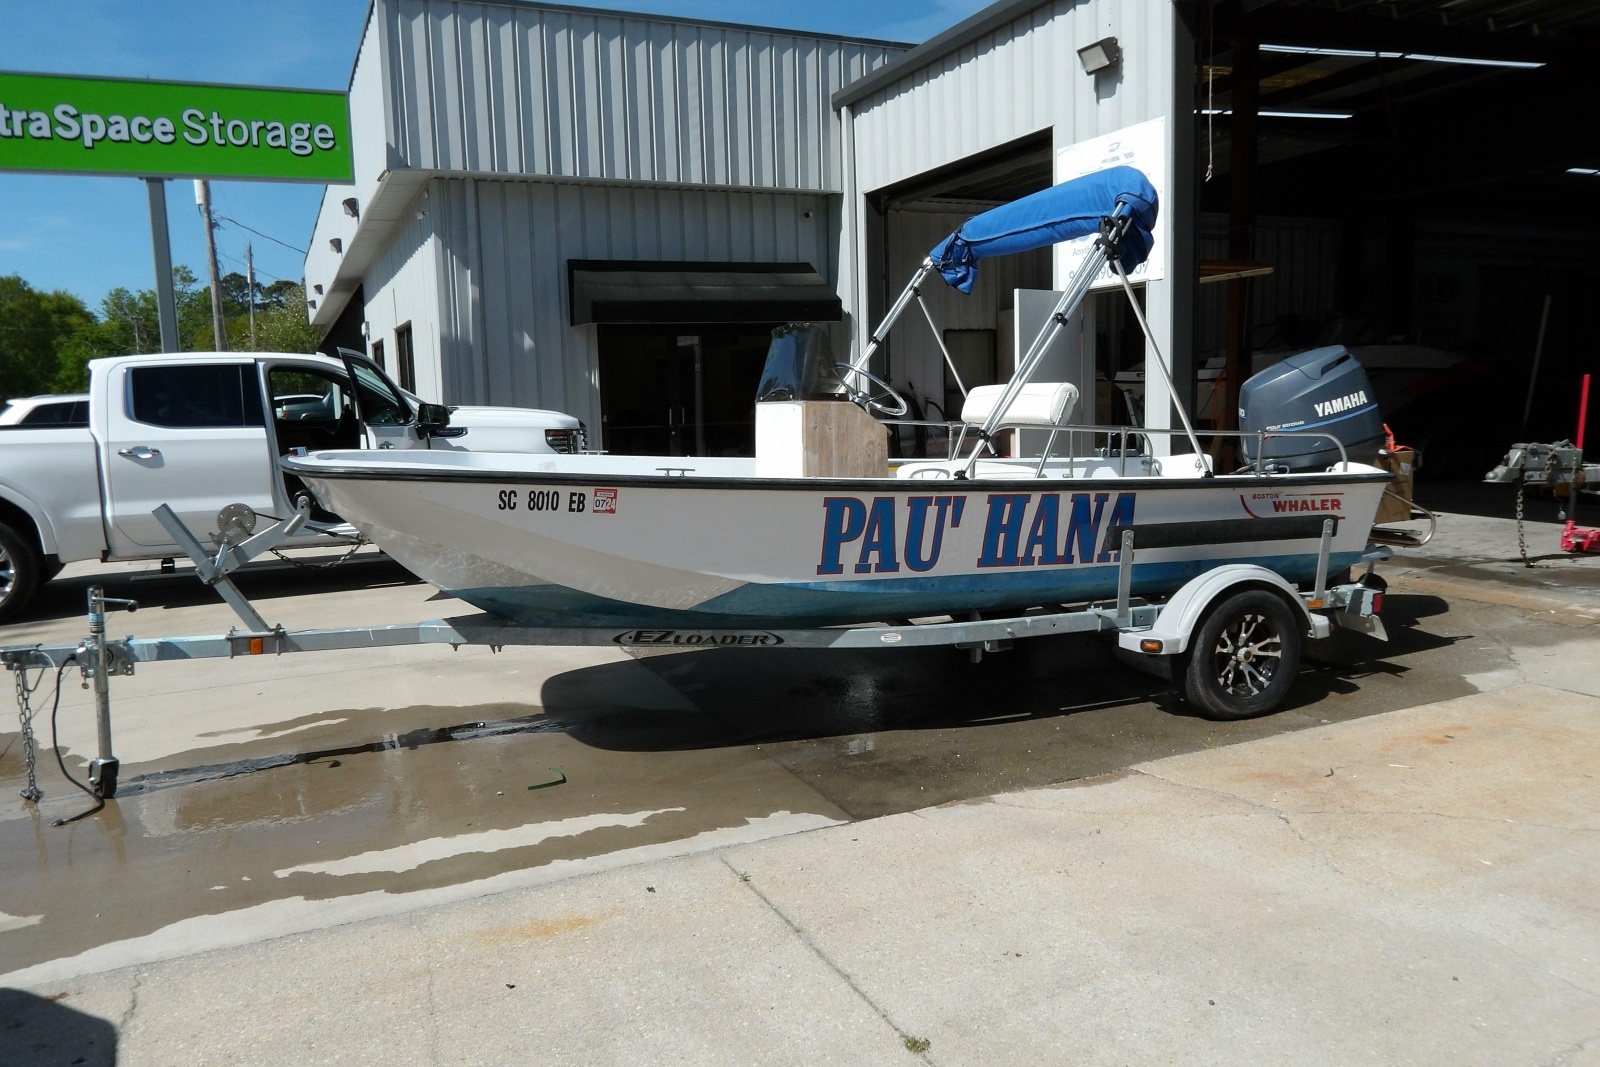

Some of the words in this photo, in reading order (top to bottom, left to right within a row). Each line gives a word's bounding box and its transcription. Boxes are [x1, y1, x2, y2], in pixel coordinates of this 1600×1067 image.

[181, 108, 337, 156] Storage
[1314, 390, 1368, 418] YAMAHA
[498, 490, 517, 511] SC
[528, 490, 560, 511] 8010
[568, 492, 586, 513] EB
[1272, 498, 1342, 513] WHALER
[976, 492, 1137, 569] HANA
